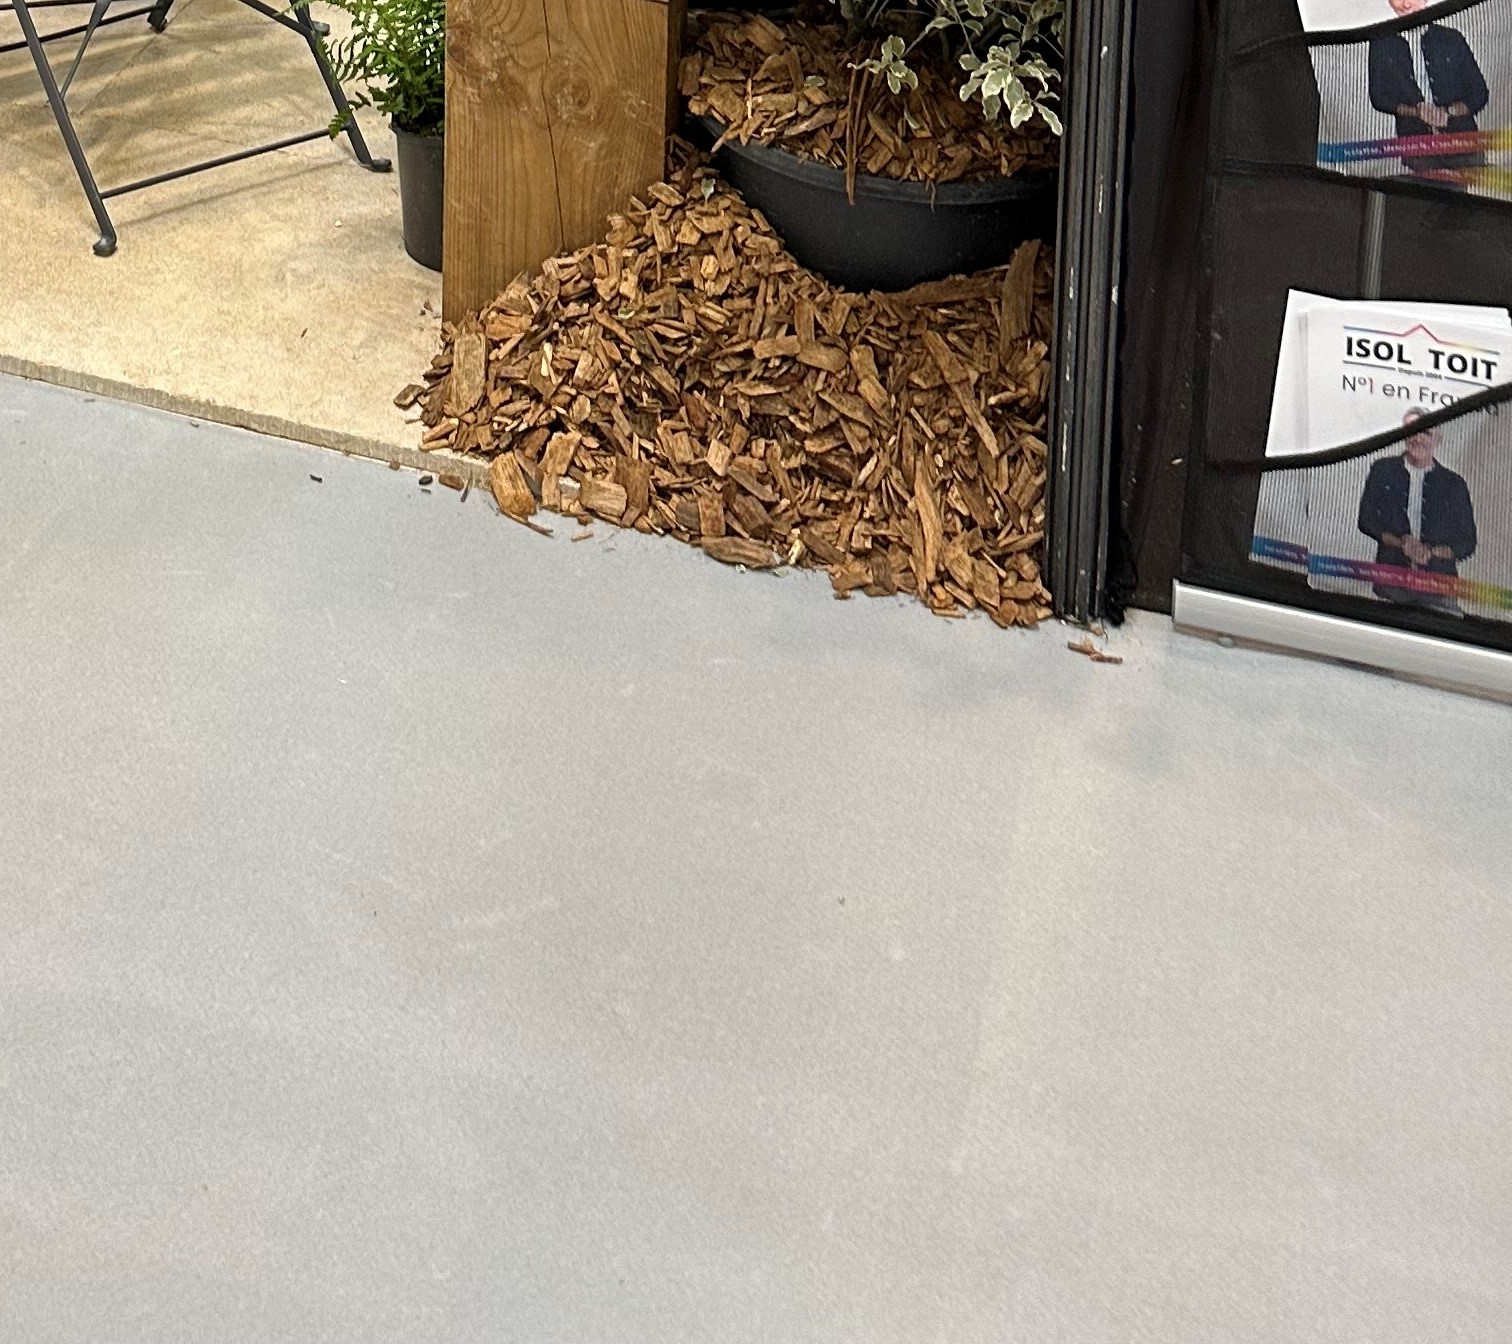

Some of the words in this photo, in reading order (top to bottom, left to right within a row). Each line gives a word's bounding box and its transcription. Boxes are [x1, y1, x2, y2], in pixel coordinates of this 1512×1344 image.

[1346, 336, 1412, 365] ISOL
[1428, 348, 1498, 381] TOIT
[1382, 383, 1411, 401] en
